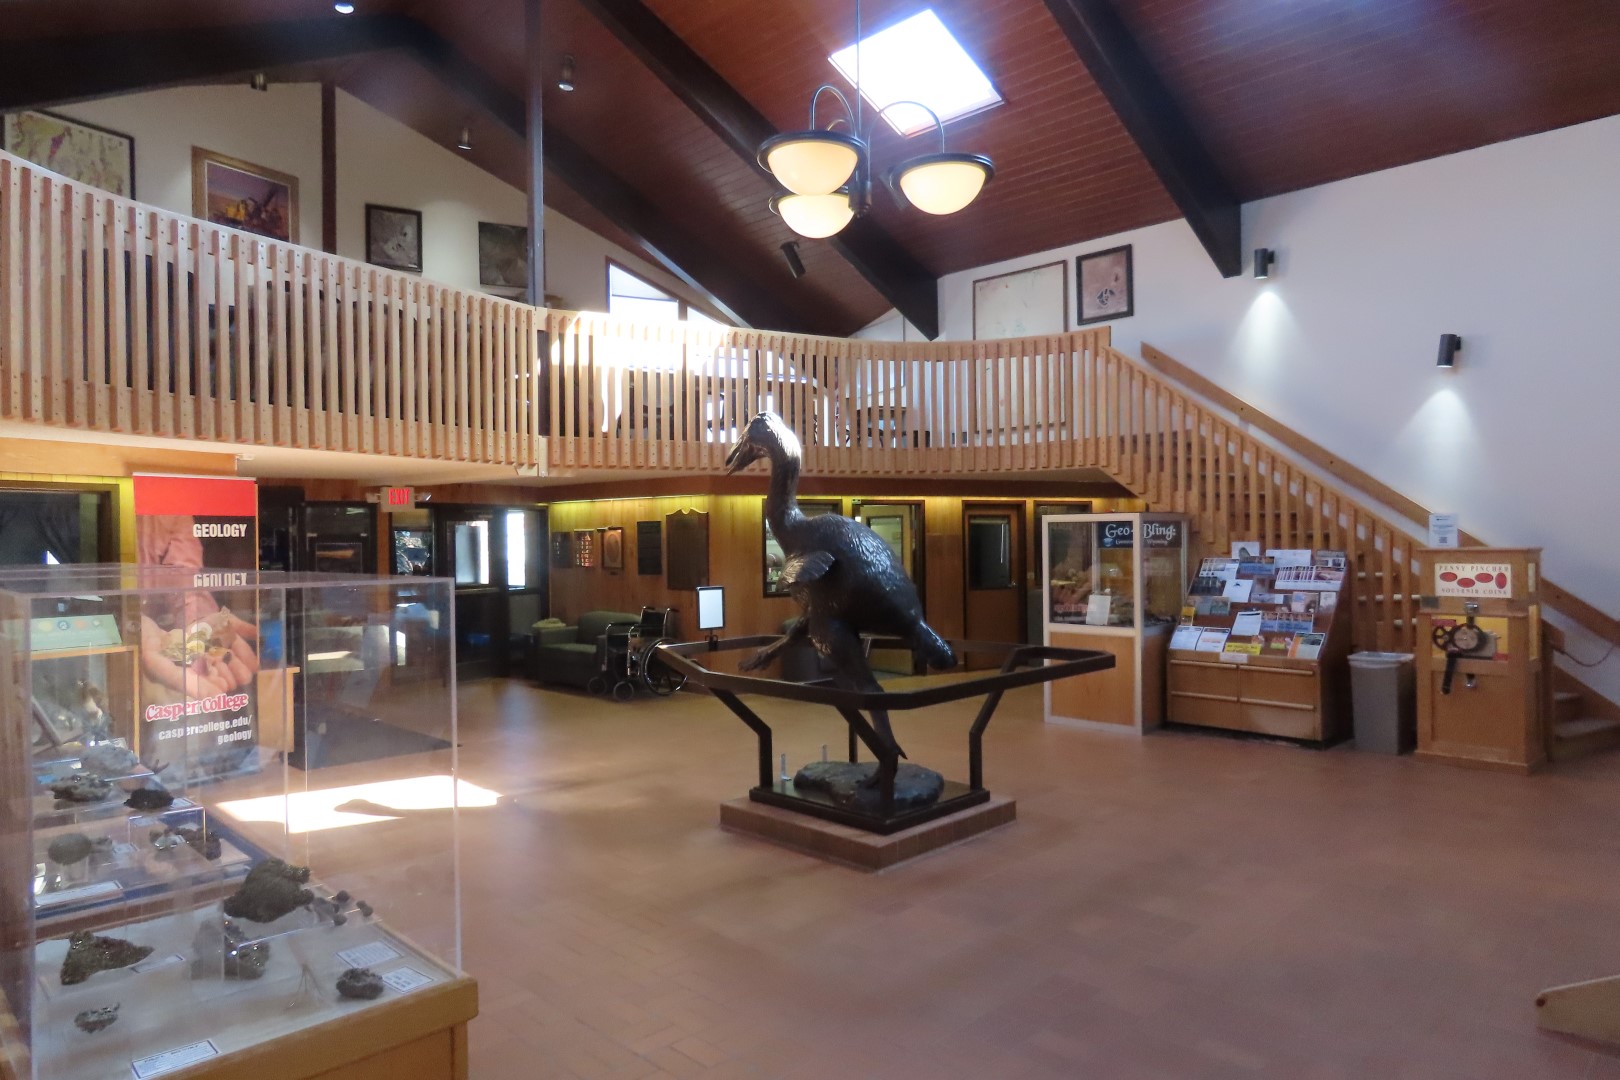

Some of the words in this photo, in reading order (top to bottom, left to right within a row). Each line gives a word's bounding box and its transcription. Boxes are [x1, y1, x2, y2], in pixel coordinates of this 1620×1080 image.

[388, 488, 410, 505] EXIT
[192, 523, 247, 538] GEOLOGY
[145, 701, 200, 722] Casper
[202, 693, 249, 714] College
[217, 729, 253, 746] geology
